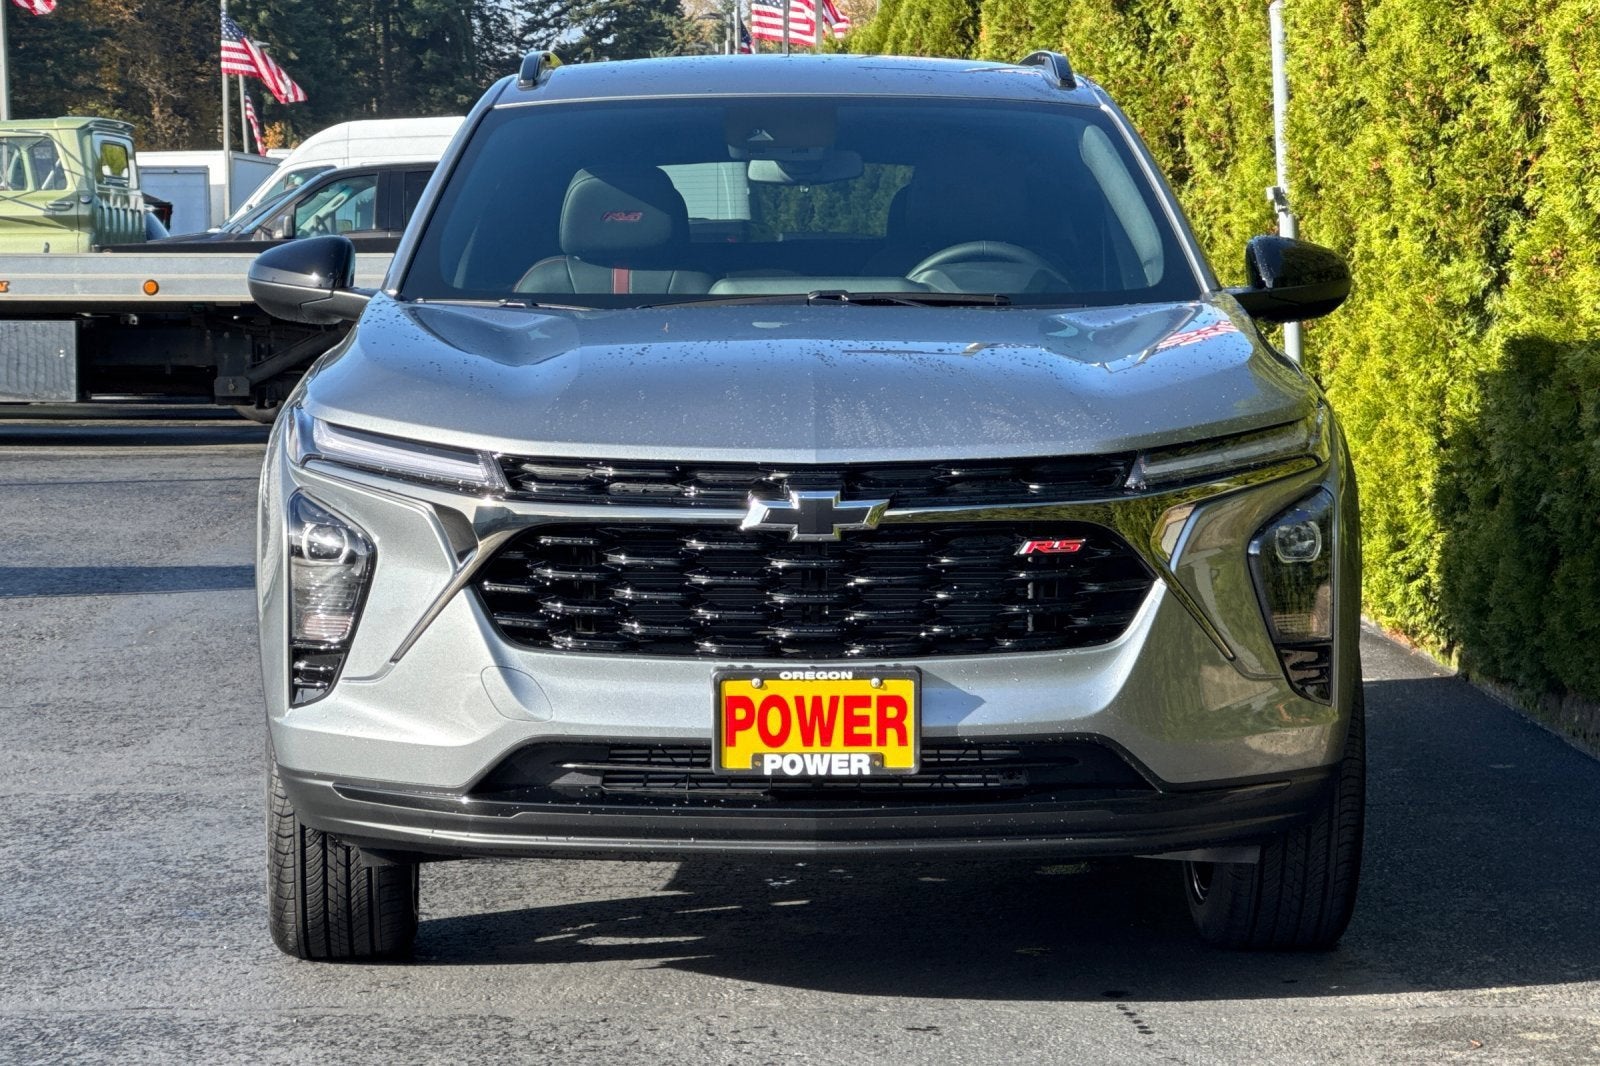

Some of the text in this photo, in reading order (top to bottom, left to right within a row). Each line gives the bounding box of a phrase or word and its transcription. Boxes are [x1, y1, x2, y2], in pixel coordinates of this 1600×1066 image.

[1016, 538, 1086, 554] RS
[779, 671, 853, 680] OREGON
[725, 694, 909, 749] POWER
[763, 753, 871, 776] POWER
